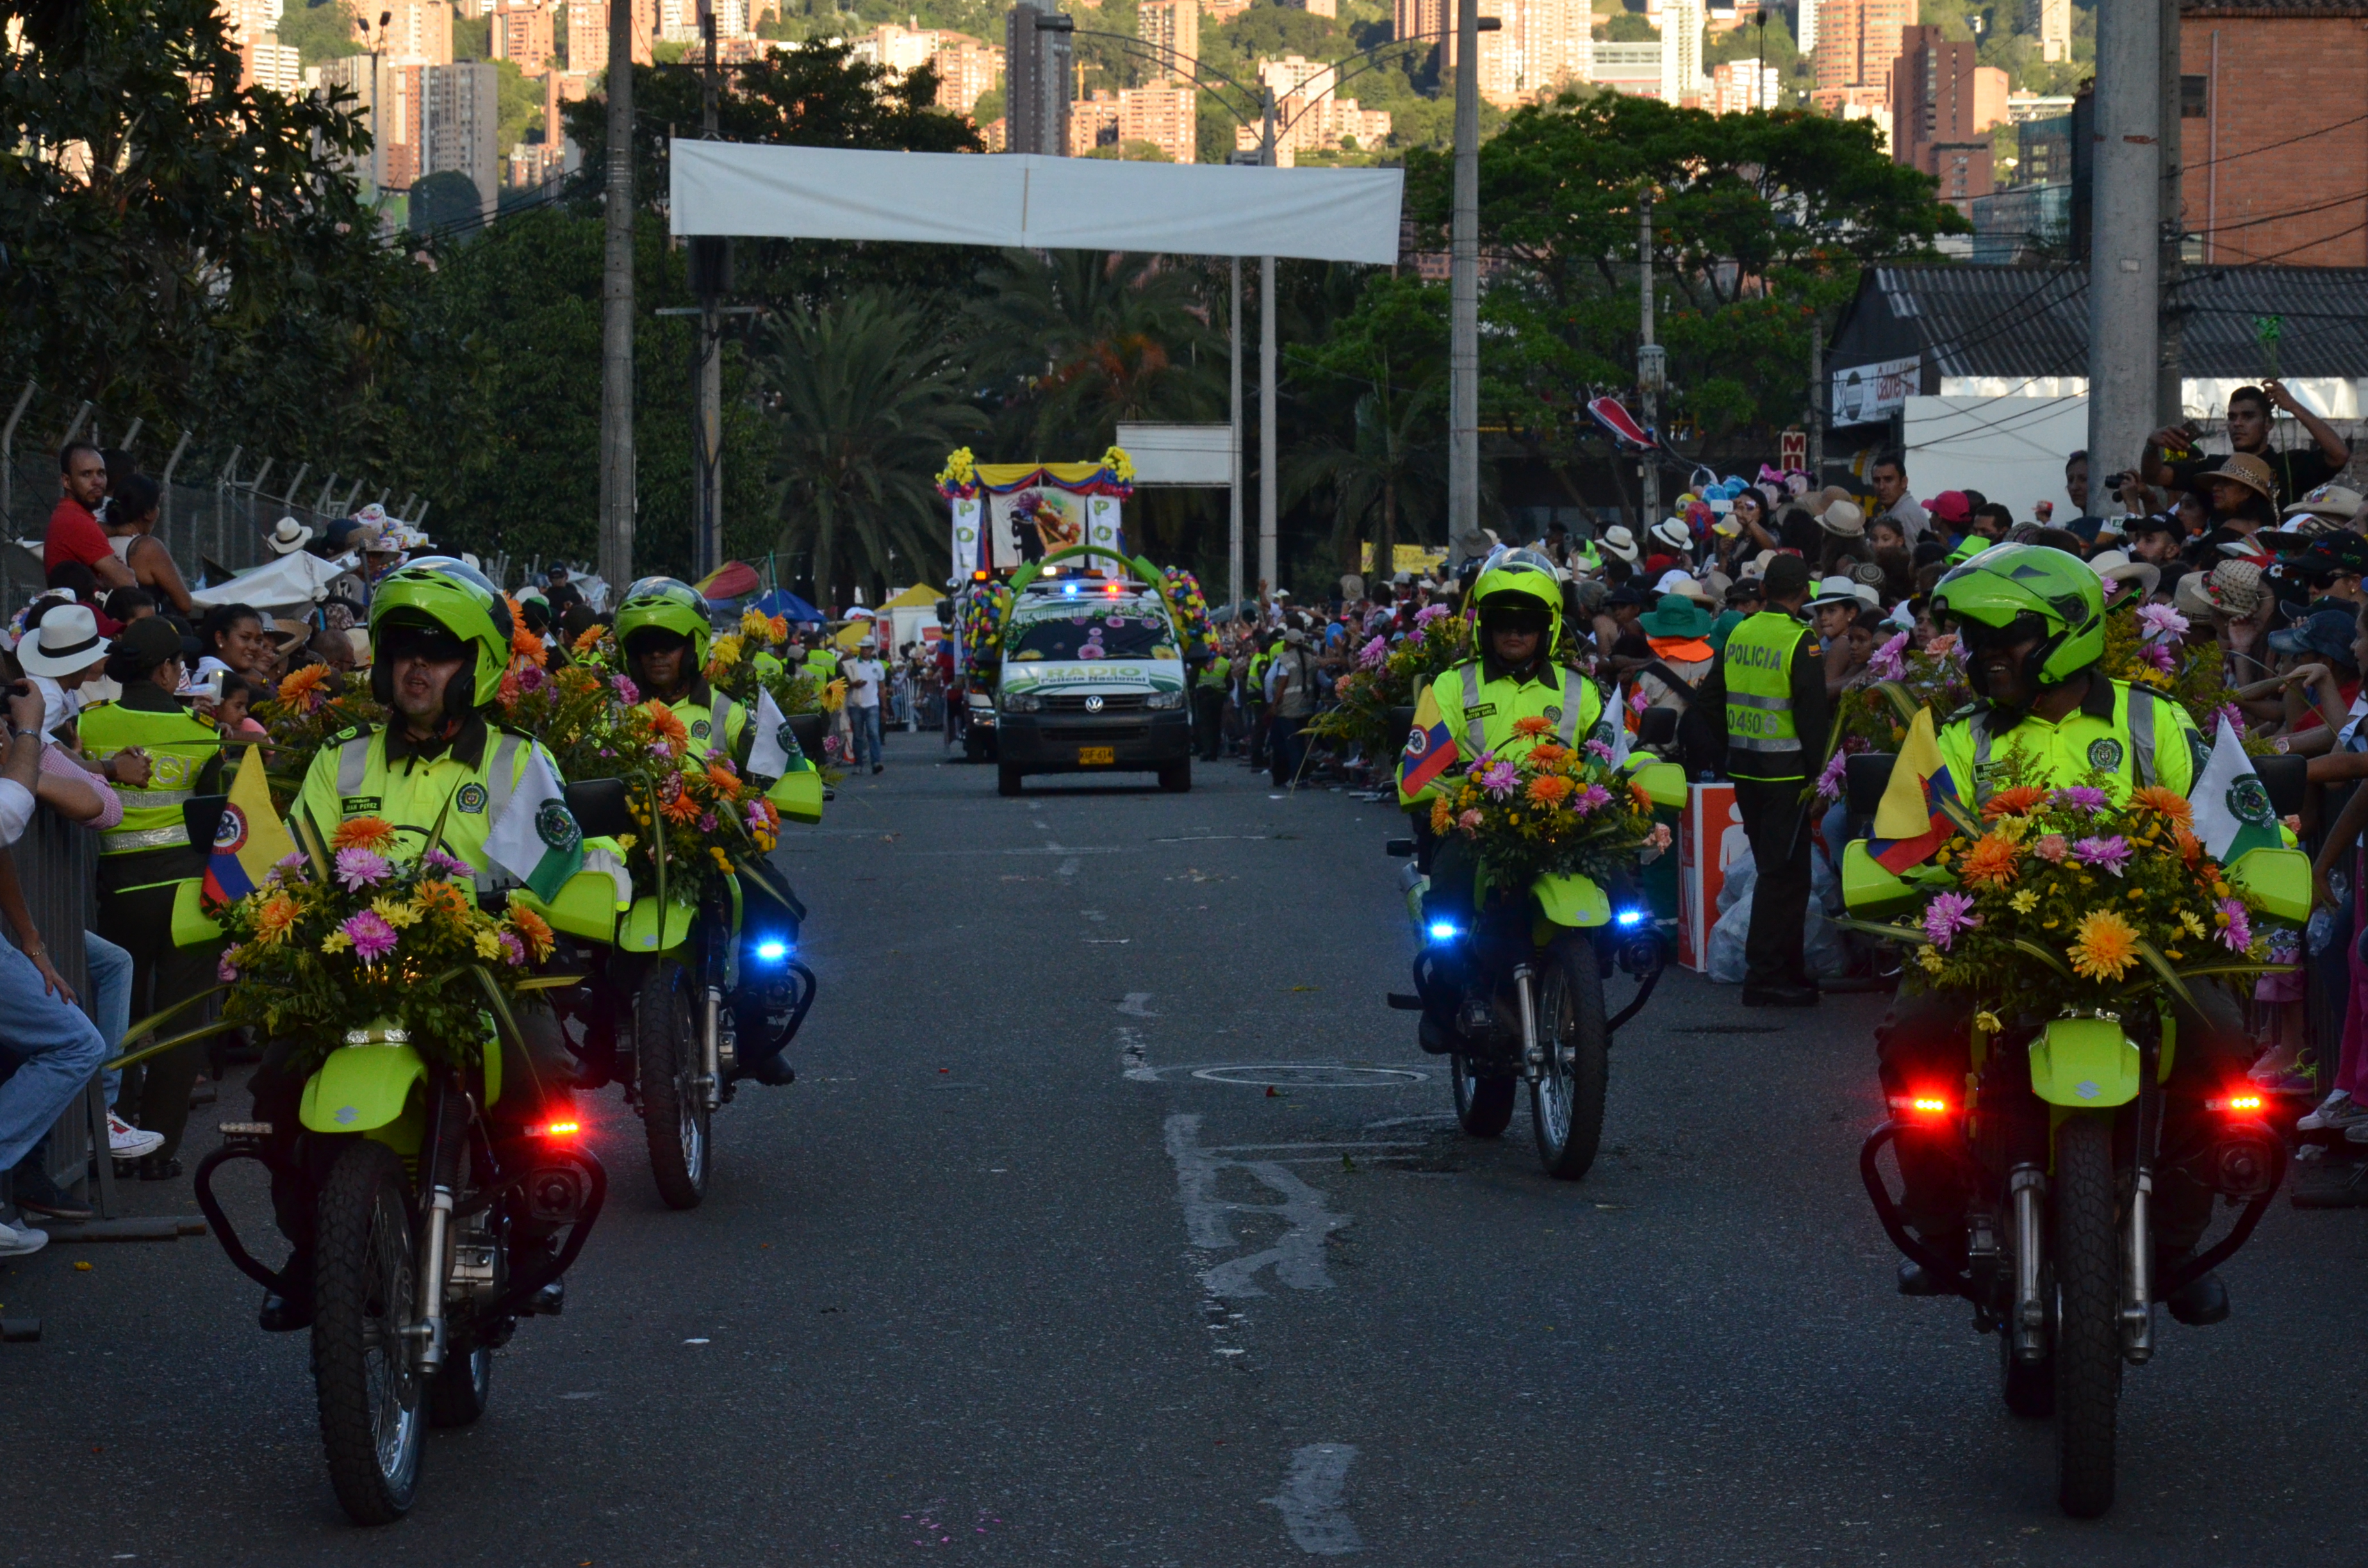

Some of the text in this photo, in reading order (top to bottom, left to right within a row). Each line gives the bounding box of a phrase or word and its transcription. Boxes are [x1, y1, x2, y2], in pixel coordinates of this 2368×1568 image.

[1725, 643, 1782, 671] POLICIA
[1047, 667, 1140, 677] RADIO
[1728, 709, 1778, 735] 04506
